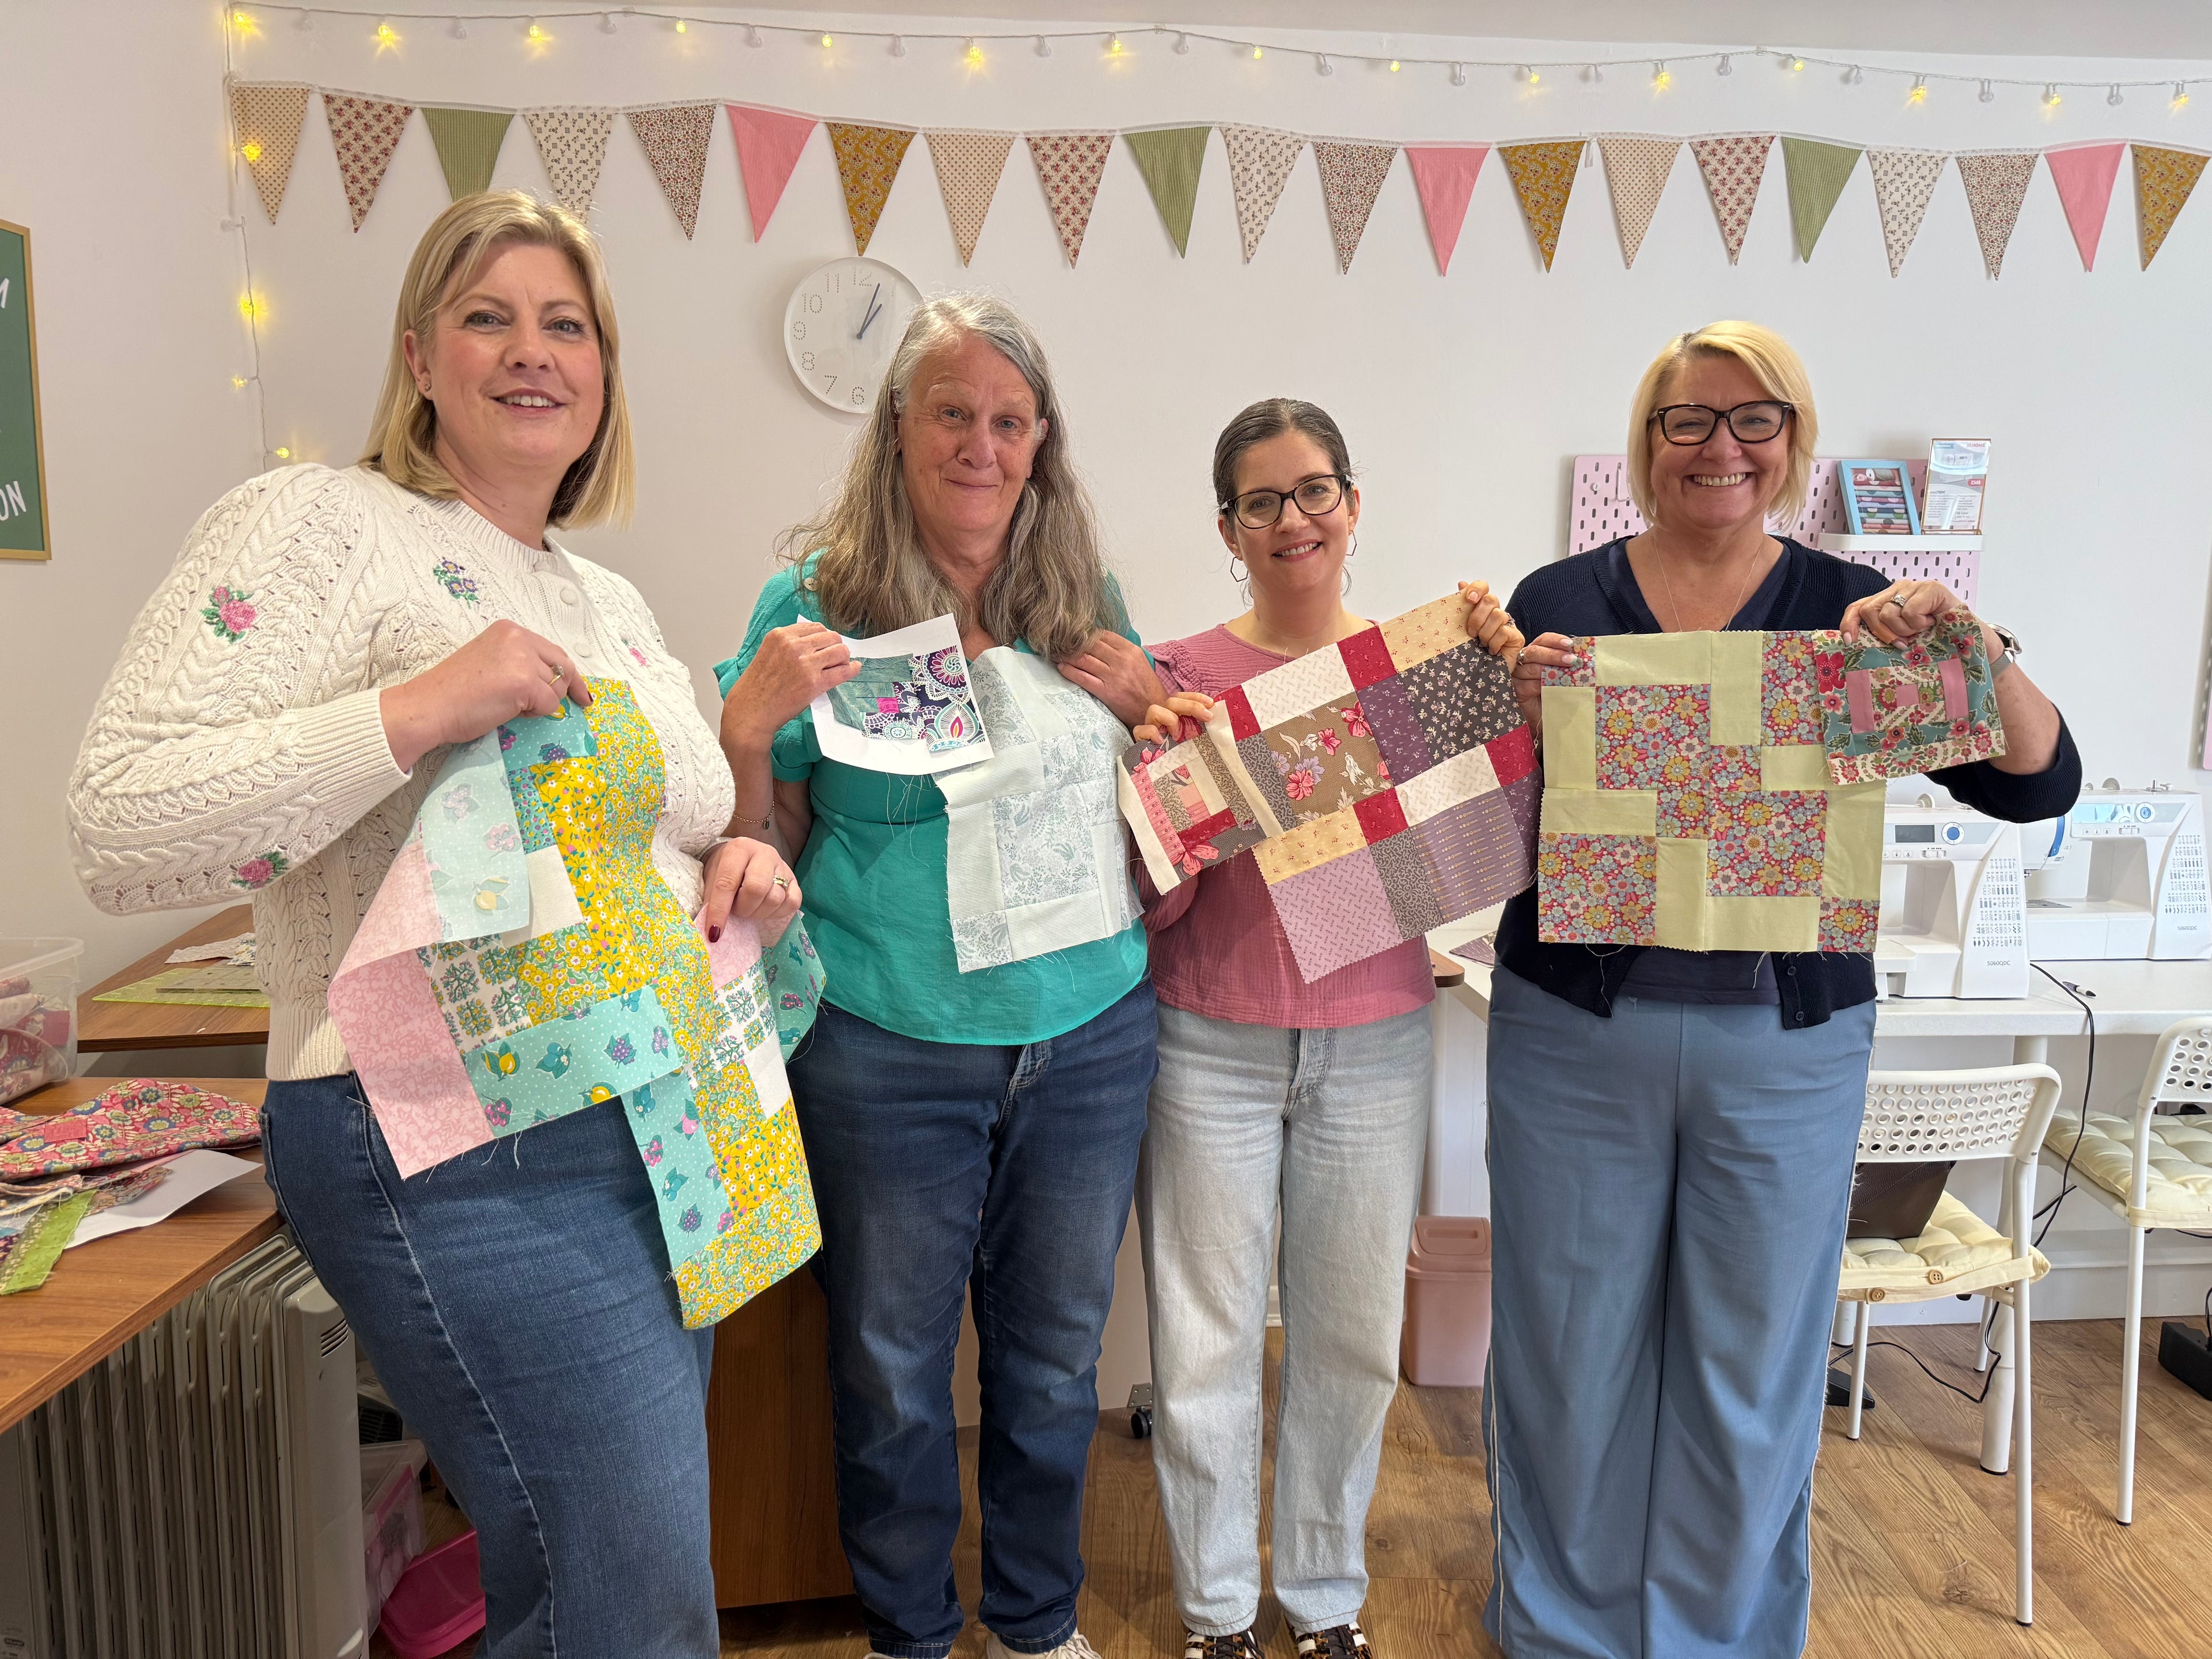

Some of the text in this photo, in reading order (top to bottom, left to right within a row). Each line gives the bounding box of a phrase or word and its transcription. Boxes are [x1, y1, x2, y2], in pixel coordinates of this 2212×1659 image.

[825, 272, 840, 293] 11
[852, 267, 873, 287] 12
[802, 293, 823, 313] 10
[793, 321, 806, 340] 9
[802, 351, 815, 371] 8
[824, 374, 838, 395] 7
[852, 386, 865, 406] 6
